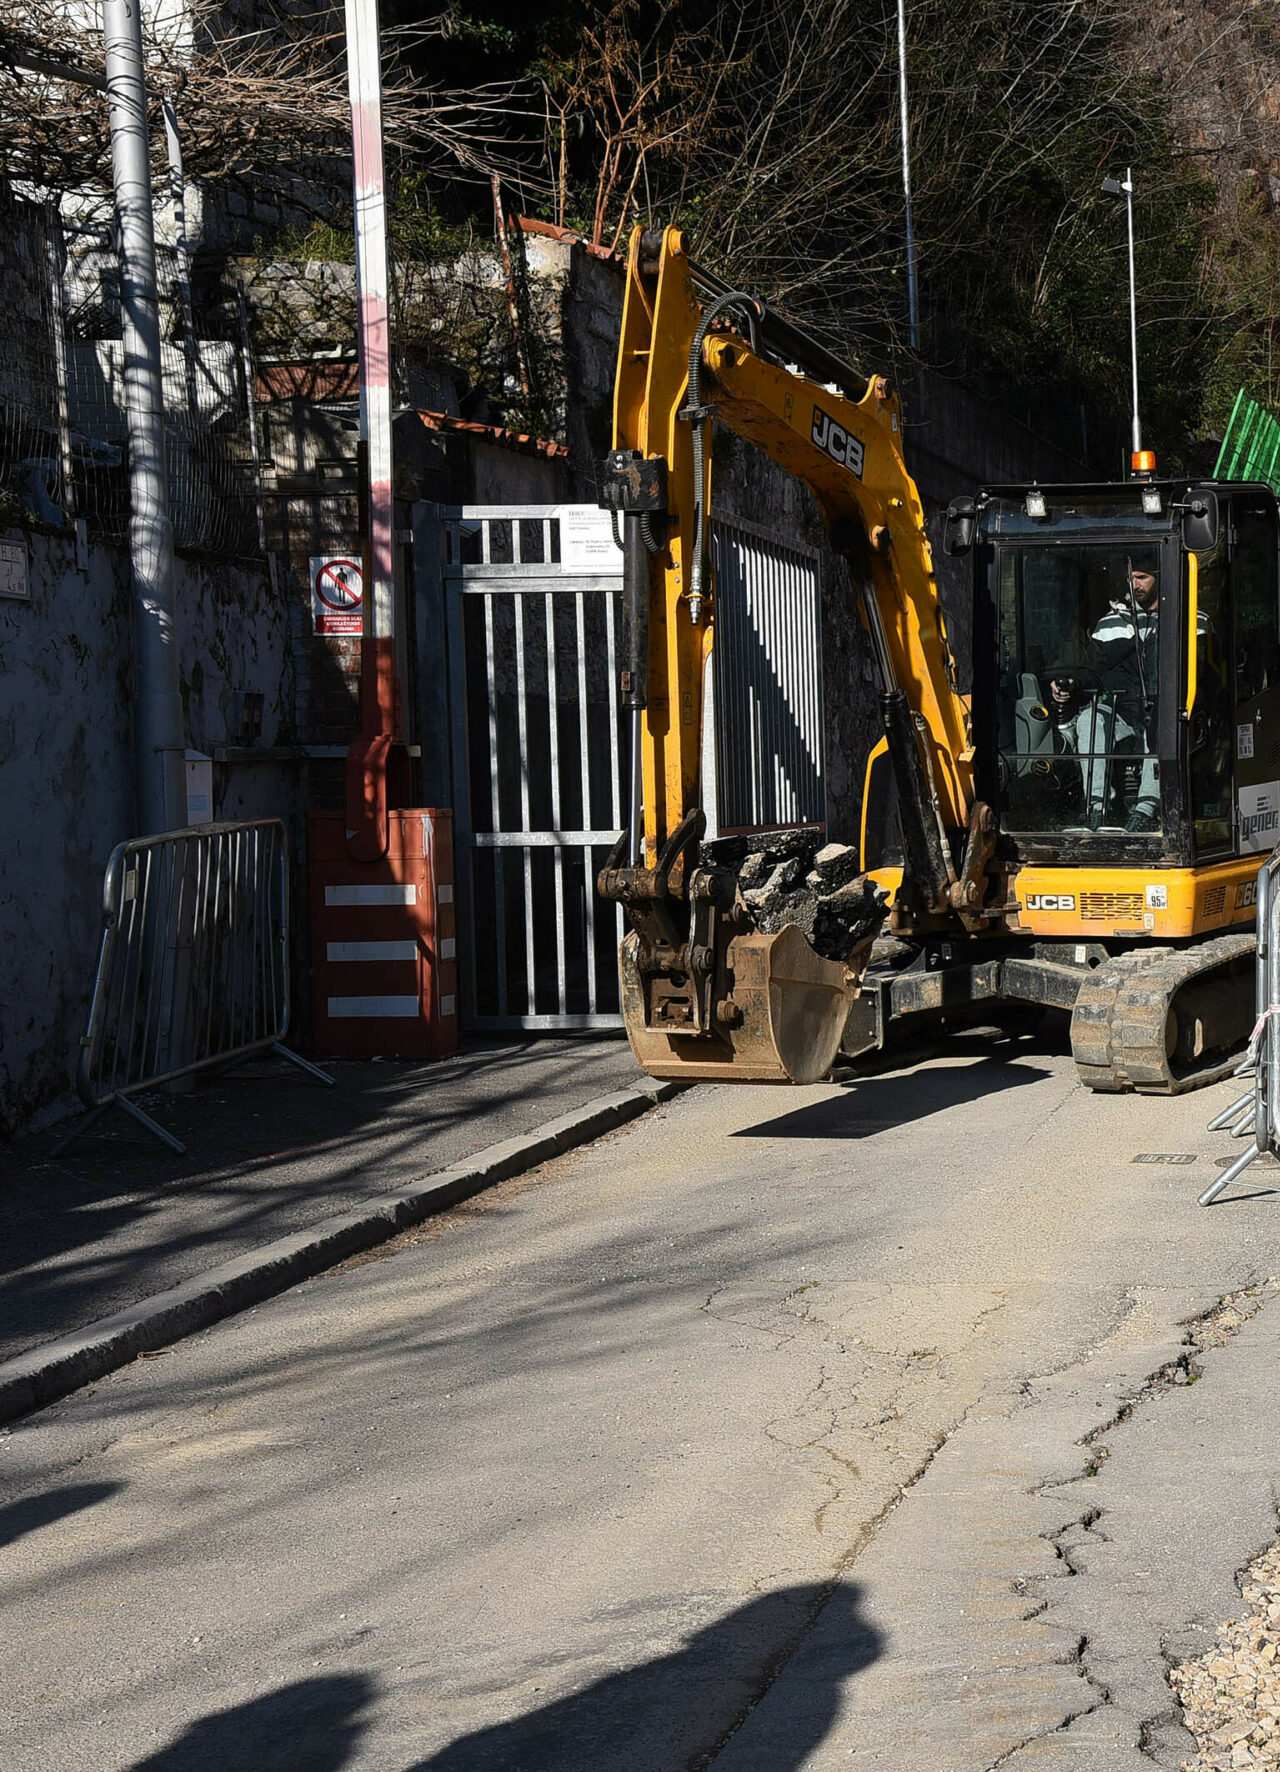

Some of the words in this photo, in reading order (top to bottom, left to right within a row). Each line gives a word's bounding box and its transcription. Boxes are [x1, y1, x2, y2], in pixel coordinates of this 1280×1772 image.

[812, 415, 863, 476] JCB
[1027, 895, 1075, 910] JCB
[1151, 895, 1161, 908] 95
